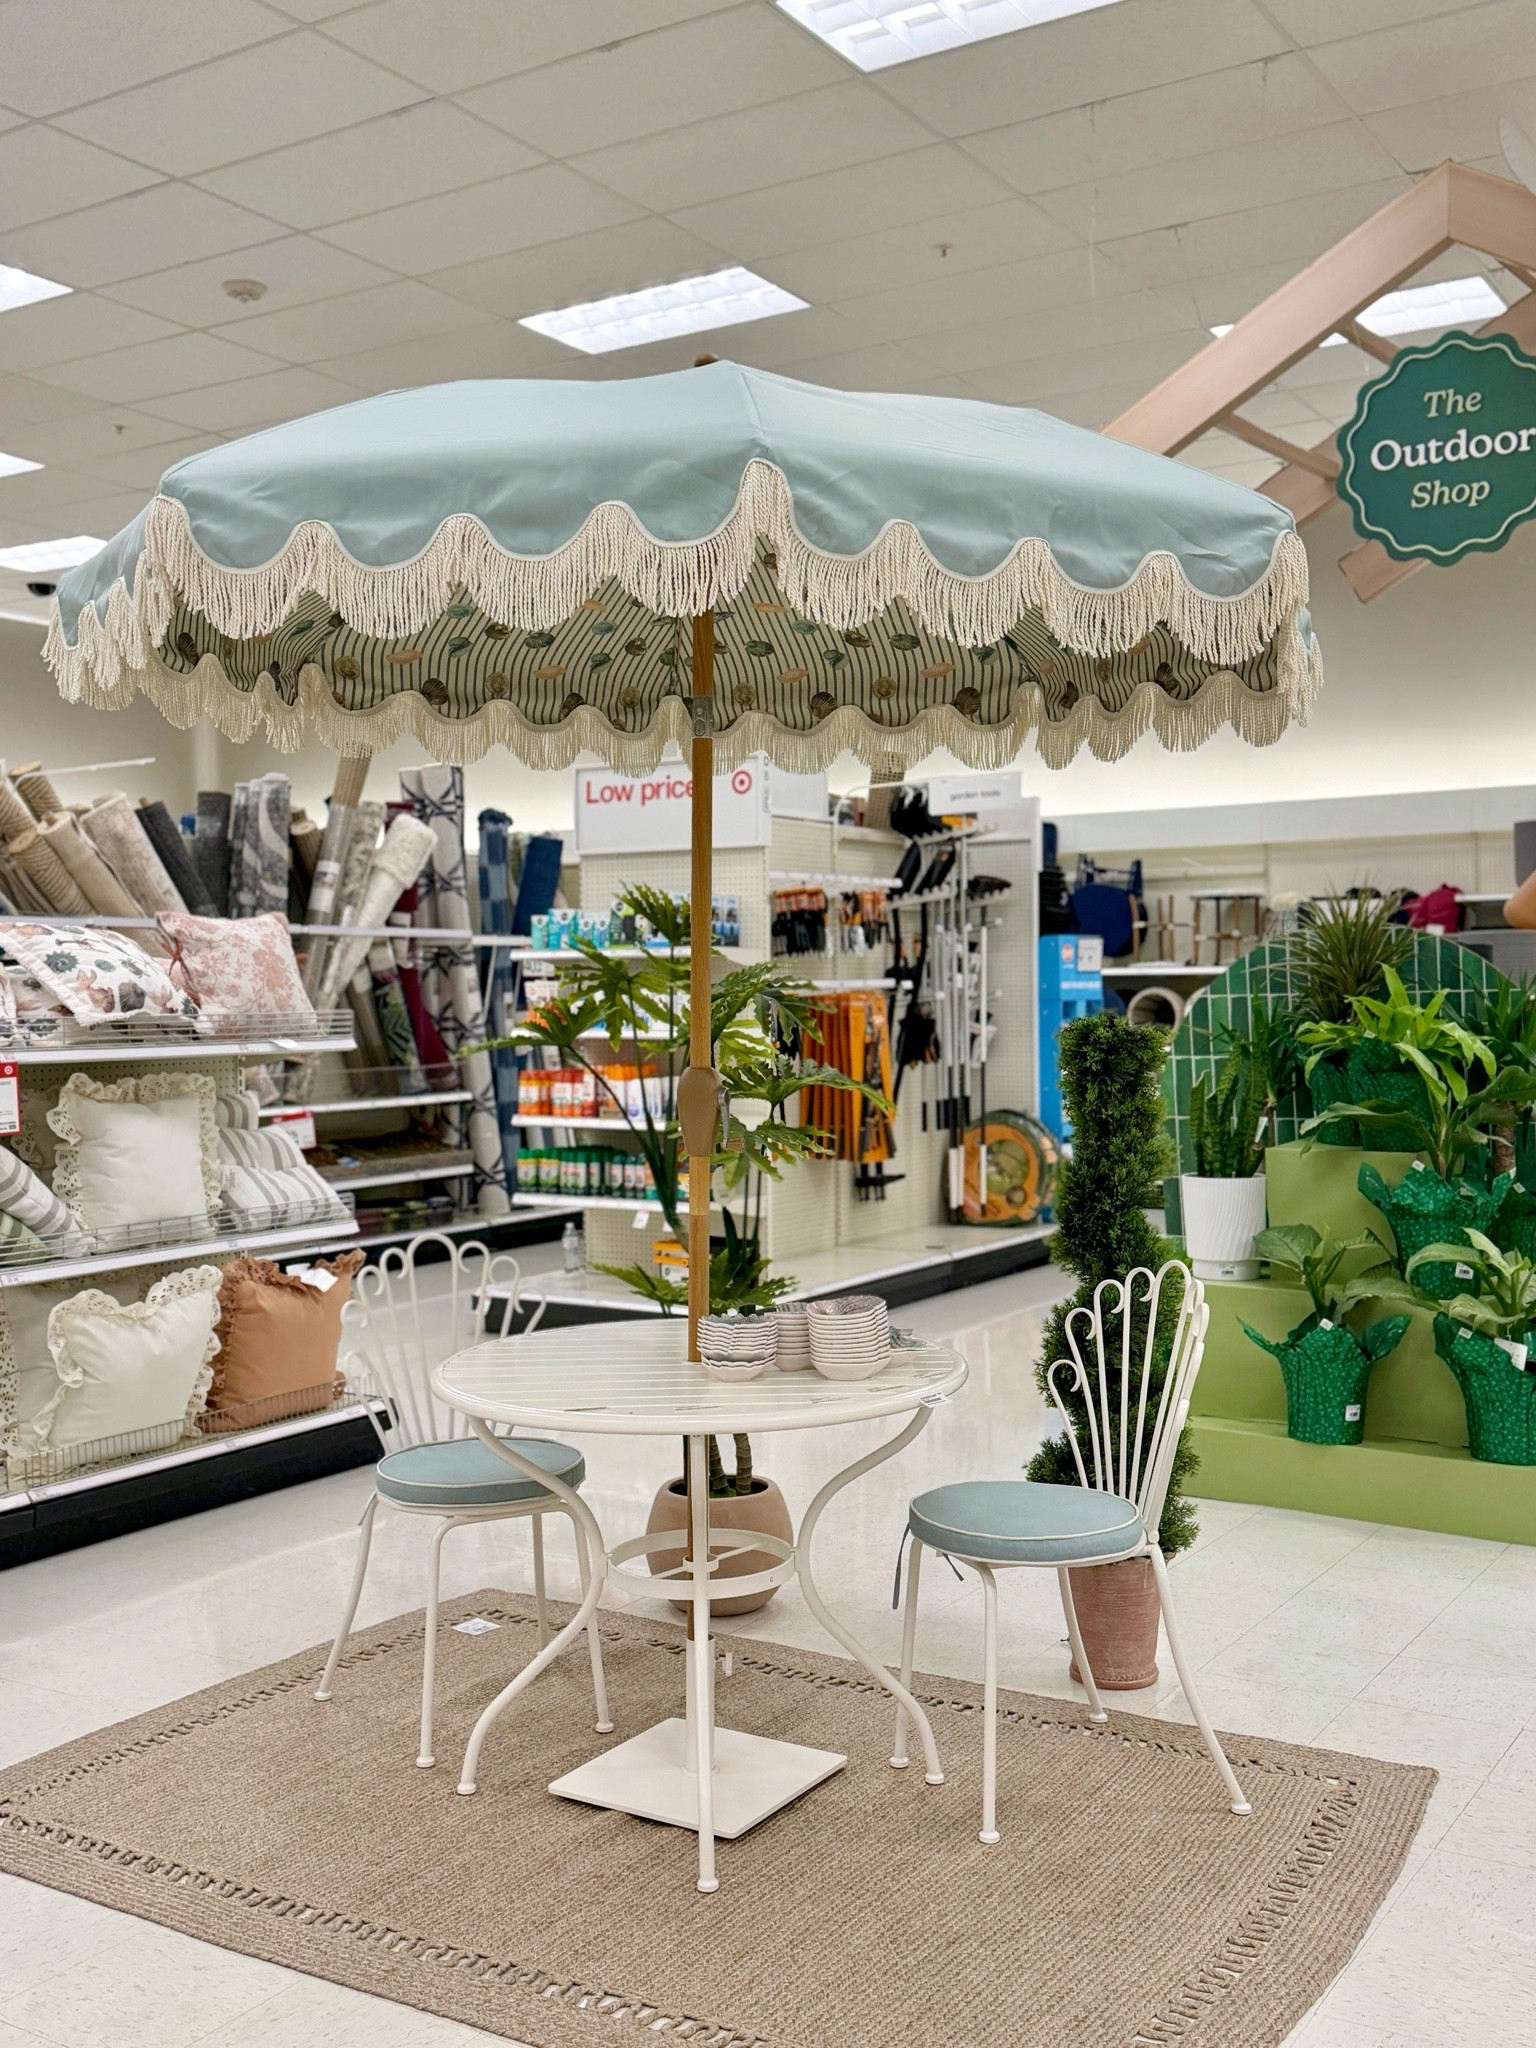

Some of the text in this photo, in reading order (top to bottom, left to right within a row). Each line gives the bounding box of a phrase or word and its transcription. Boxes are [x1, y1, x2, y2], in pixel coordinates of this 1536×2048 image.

[1424, 388, 1482, 418] The
[1370, 427, 1536, 472] Outdoor
[1411, 479, 1491, 509] Shop
[585, 780, 634, 804] Low
